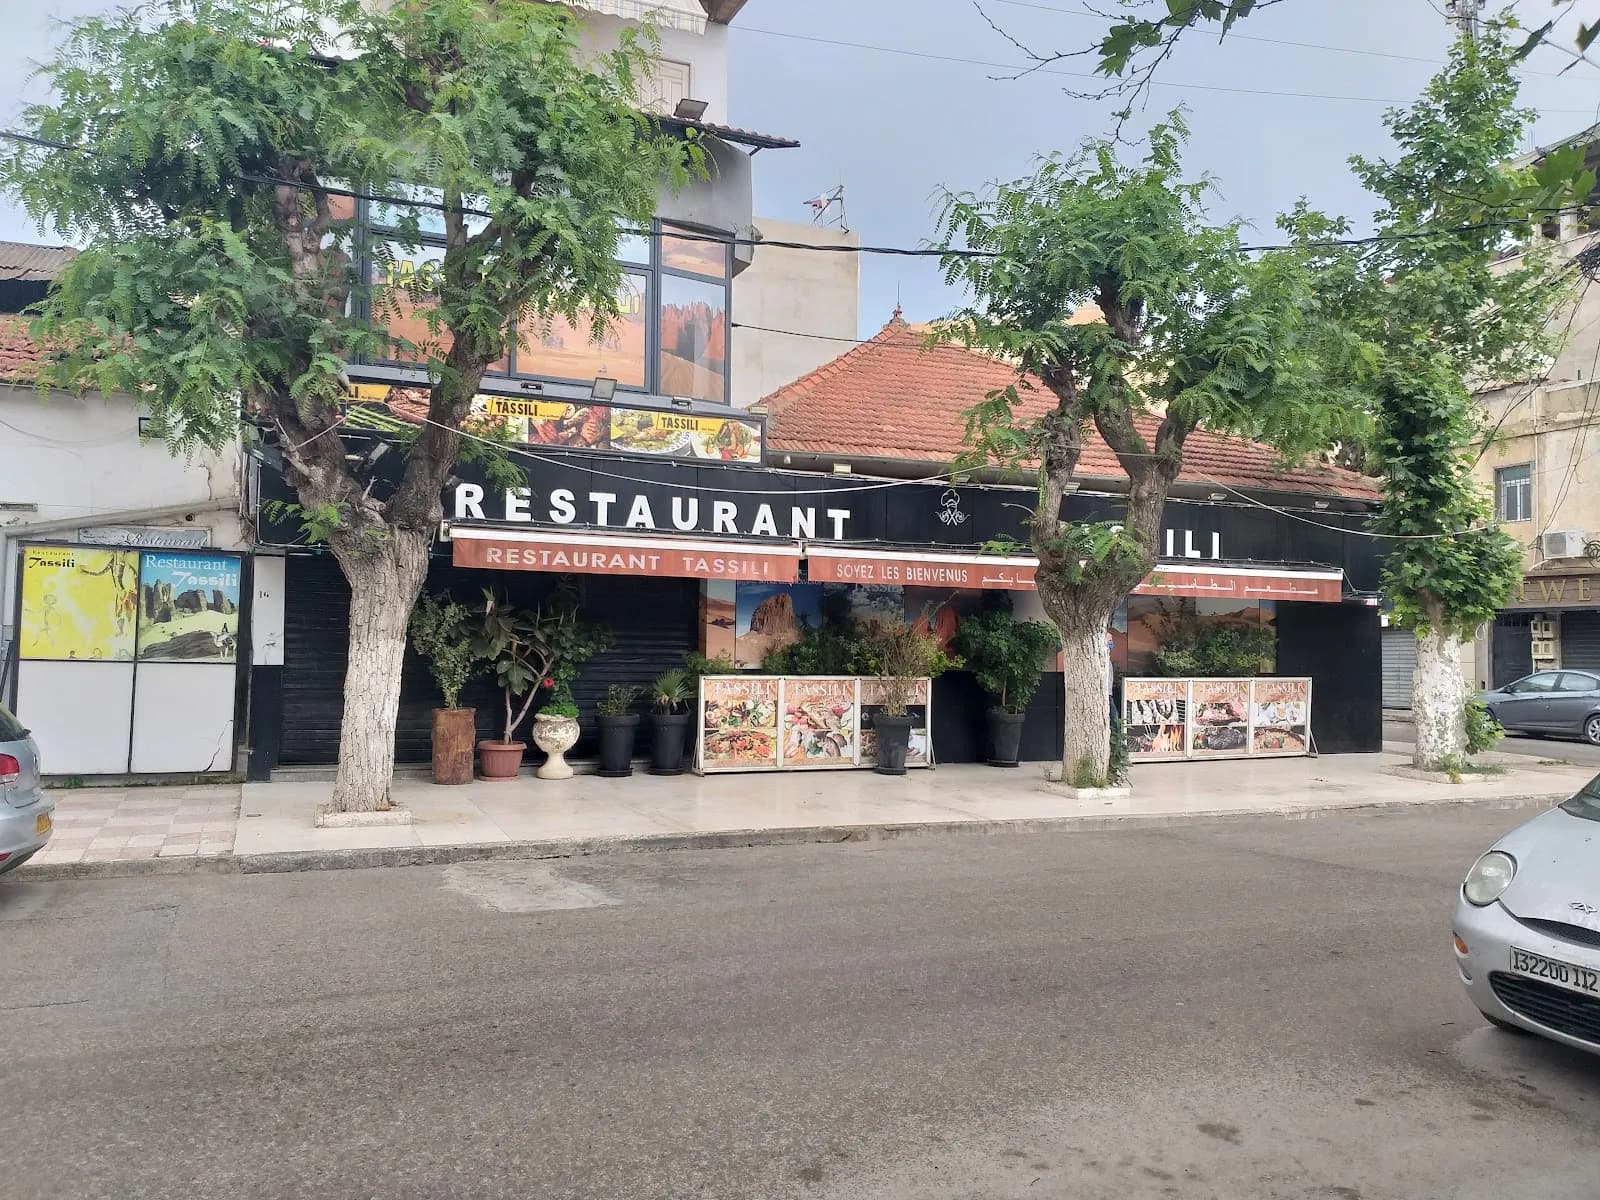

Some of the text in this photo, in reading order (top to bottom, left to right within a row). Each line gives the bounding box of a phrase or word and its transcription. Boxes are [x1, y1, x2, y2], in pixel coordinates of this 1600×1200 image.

[496, 401, 538, 416] TASSILI
[661, 416, 699, 431] TASSILI
[455, 483, 850, 540] RESTAURANT
[29, 557, 75, 569] Tassili
[145, 555, 228, 570] Restaurant
[486, 547, 769, 576] RESTAURANT TASSILI
[172, 571, 237, 587] Tassili
[836, 564, 968, 583] SOYEZ LES BIENVENUS
[1243, 582, 1319, 597] مطعم
[714, 682, 771, 695] TASSILI
[795, 684, 848, 696] TASSILI
[1513, 951, 1599, 992] 132200 112
